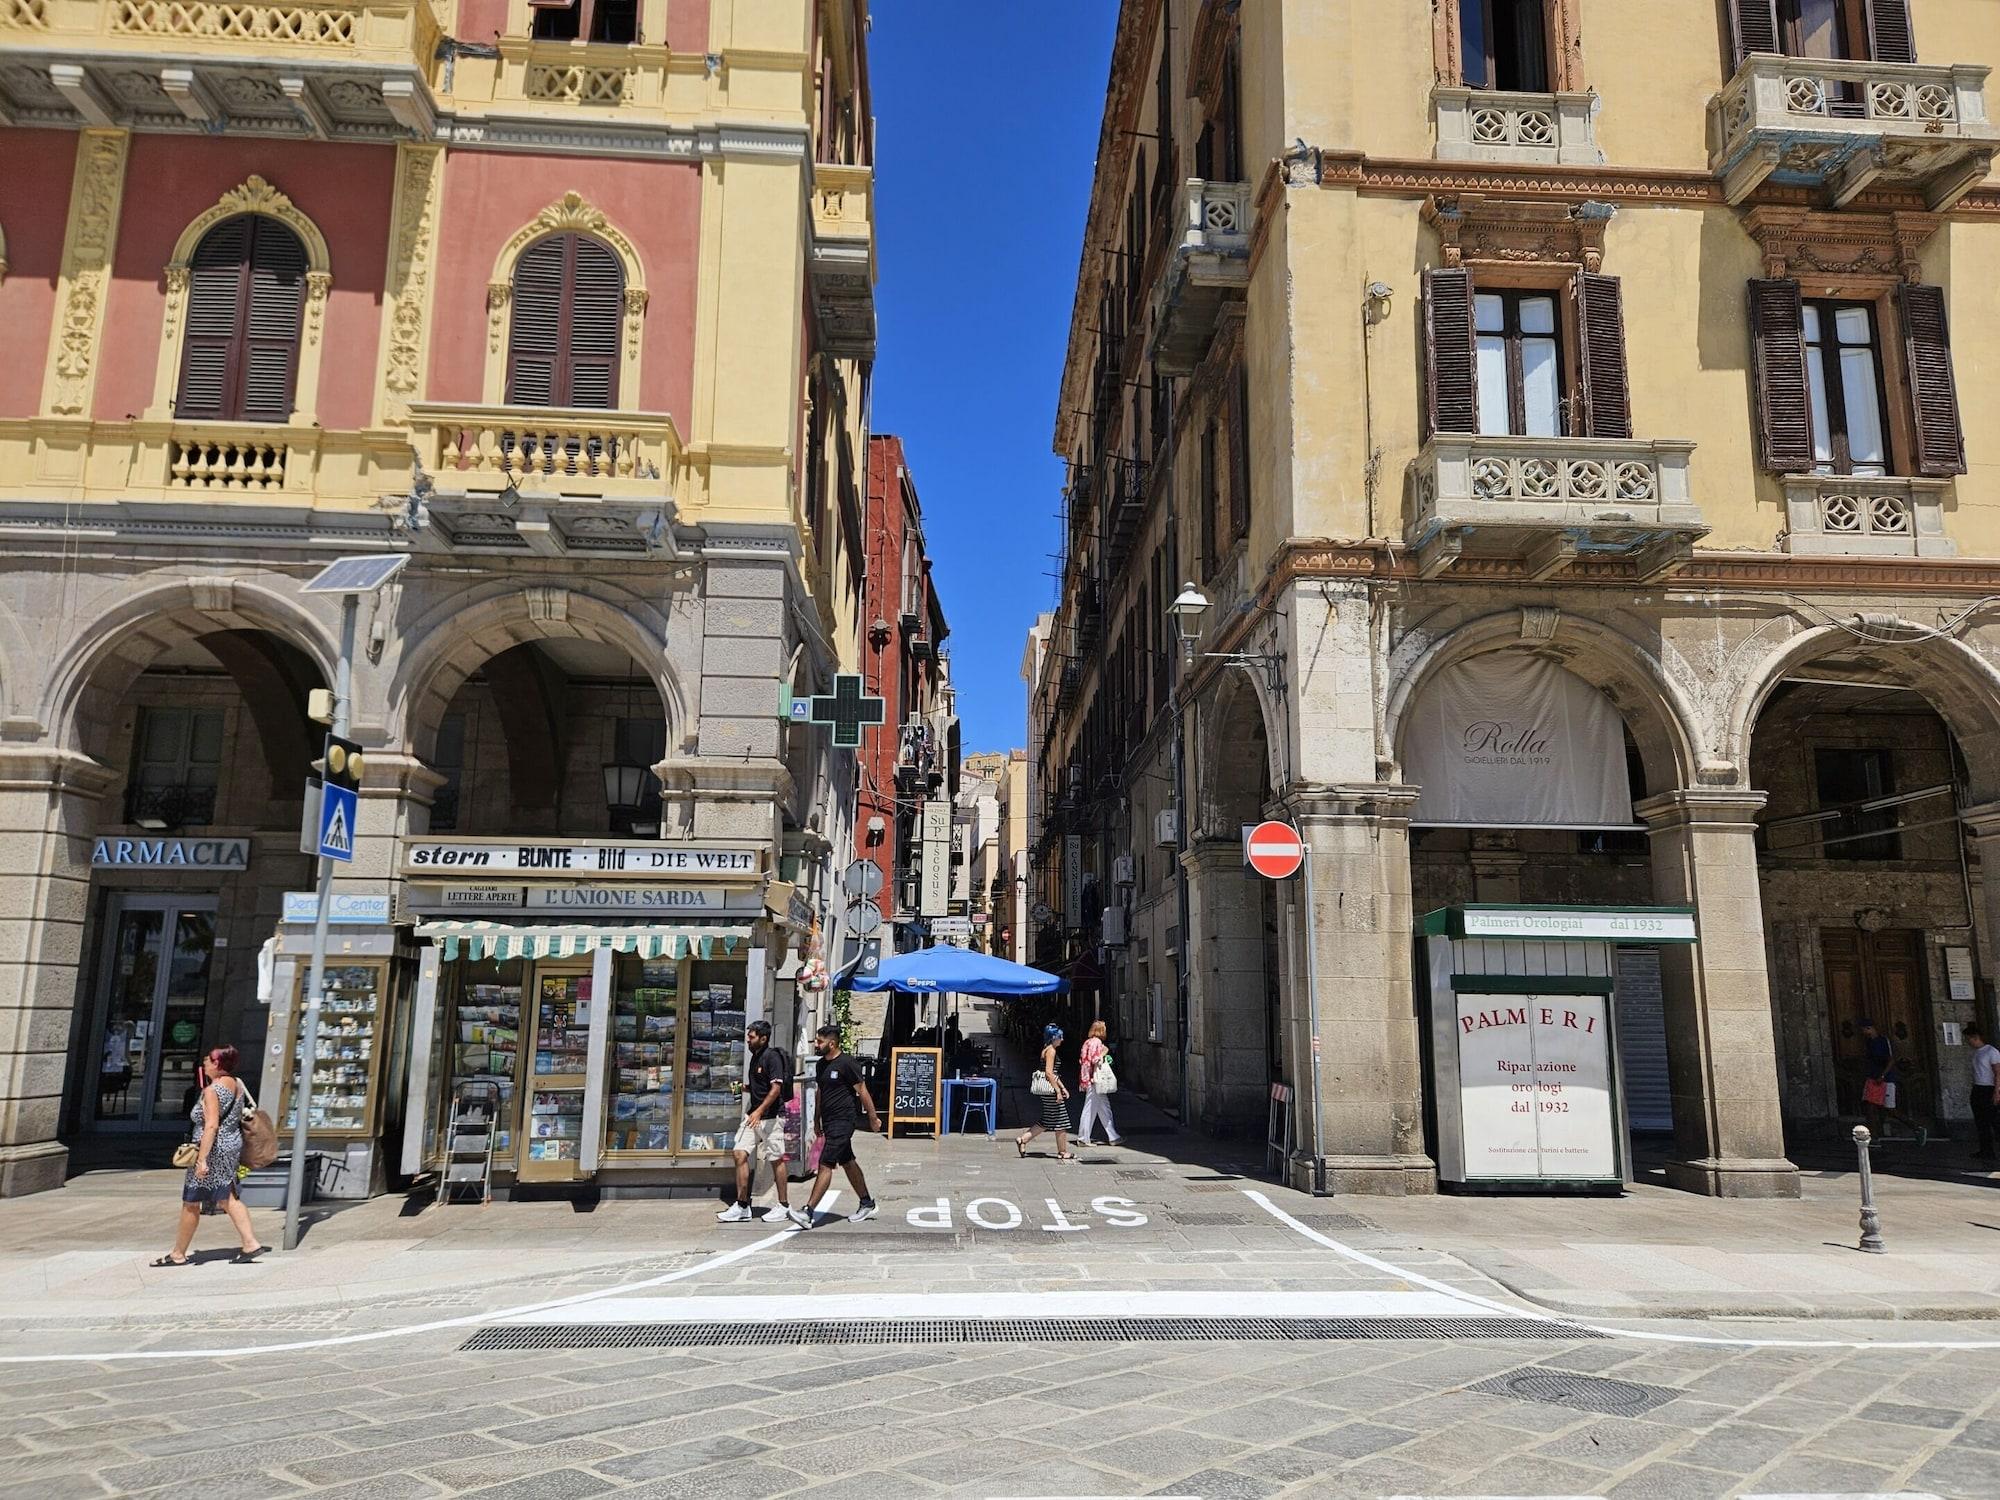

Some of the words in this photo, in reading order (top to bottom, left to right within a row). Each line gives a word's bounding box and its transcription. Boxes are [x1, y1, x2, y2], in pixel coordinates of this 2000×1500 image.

[1464, 721, 1552, 754] Rolla
[1510, 757, 1527, 765] DAL
[1529, 757, 1551, 765] 1919
[930, 815, 945, 826] Su
[92, 839, 247, 865] ARMACIA
[413, 846, 490, 866] stern
[518, 847, 572, 868] BUNTE
[598, 848, 626, 870] Bild
[651, 852, 688, 868] DIE
[696, 854, 752, 869] WELT
[336, 895, 386, 912] Center
[448, 892, 484, 901] LETTERE
[486, 892, 518, 902] APERTE
[642, 889, 707, 906] SARDA
[1470, 915, 1520, 928] Palmeri
[1523, 916, 1584, 932] Orologiai
[1610, 917, 1629, 930] dal
[1632, 919, 1664, 931] 1932
[1460, 1008, 1597, 1034] PALMERI
[895, 1095, 916, 1109] 25€
[1511, 1101, 1530, 1113] dal
[1539, 1101, 1570, 1113] 1932
[906, 1196, 1148, 1231] STOP
